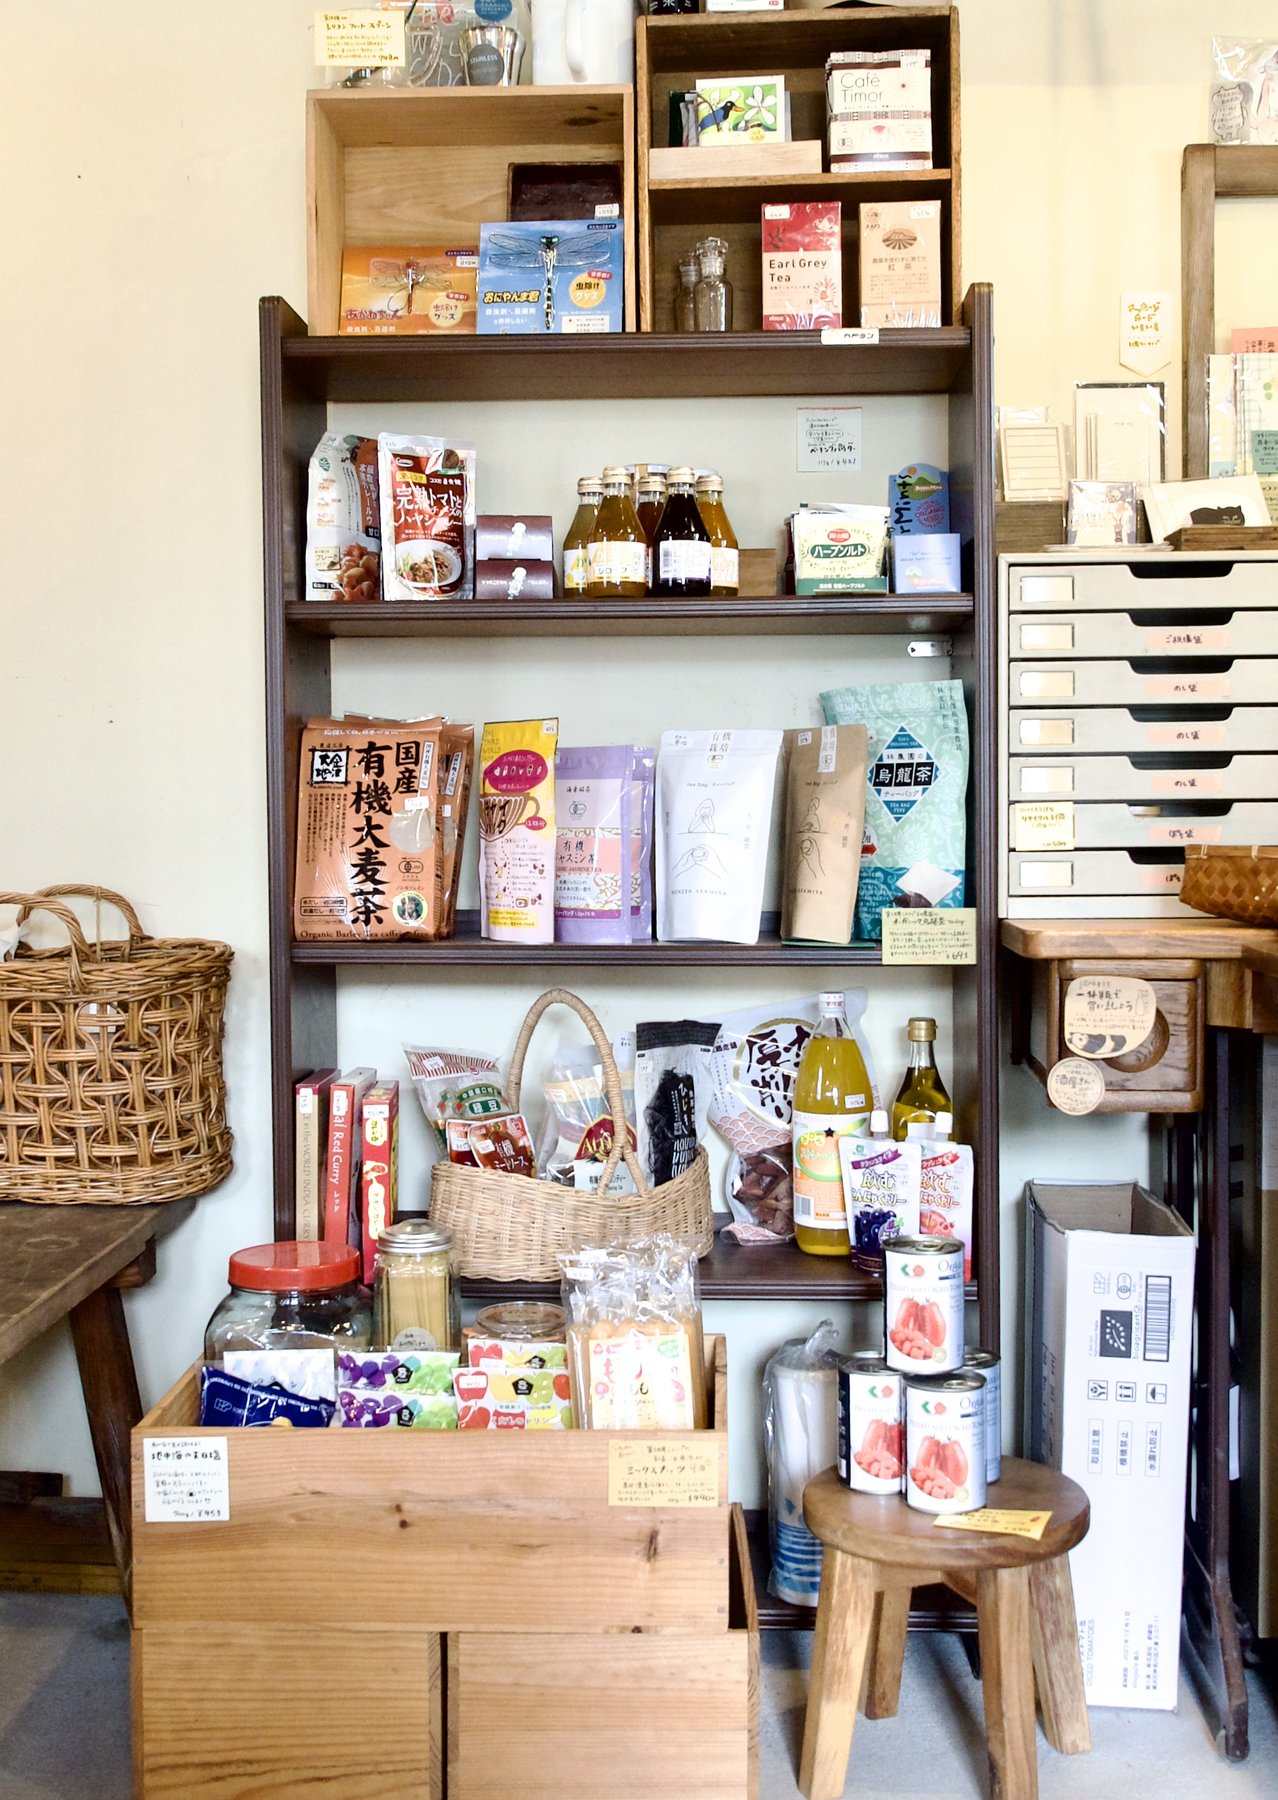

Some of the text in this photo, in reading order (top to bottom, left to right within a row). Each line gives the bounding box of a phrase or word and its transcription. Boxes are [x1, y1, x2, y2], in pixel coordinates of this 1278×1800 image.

[470, 54, 498, 64] STAINLESS
[841, 72, 880, 89] Café
[841, 90, 883, 103] Timor
[769, 258, 827, 270] Earl Grey
[576, 282, 600, 290] 虫除け
[769, 273, 791, 283] Tea
[483, 290, 541, 304] おにやんま君
[576, 292, 599, 300] グッズ
[433, 303, 458, 312] 虫除け
[396, 485, 463, 510] 完熟トマトと
[397, 511, 463, 530] ハヤシレー
[597, 567, 628, 575] シロプ
[1174, 683, 1198, 692] のし袋
[1176, 731, 1200, 740] のし袋
[392, 741, 421, 794] 国産
[876, 766, 932, 784] 烏龍茶
[1174, 778, 1197, 788] のし袋
[350, 741, 393, 926] 有機大麦茶
[562, 840, 584, 852] 有機
[300, 930, 333, 939] Organic
[335, 930, 361, 940] Barley
[472, 1100, 499, 1113] 緑豆
[332, 1132, 346, 1153] Red
[302, 1144, 311, 1177] WORLD
[329, 1155, 343, 1185] Curry
[861, 1168, 896, 1191] 飲む
[302, 1178, 311, 1207] INDIA
[302, 1209, 311, 1240] CURRY
[1134, 1314, 1142, 1359] bioagricert
[1090, 1429, 1100, 1464] 取扱注意
[1149, 1428, 1158, 1471] 水濡れ防止
[1086, 1663, 1094, 1686] DICED
